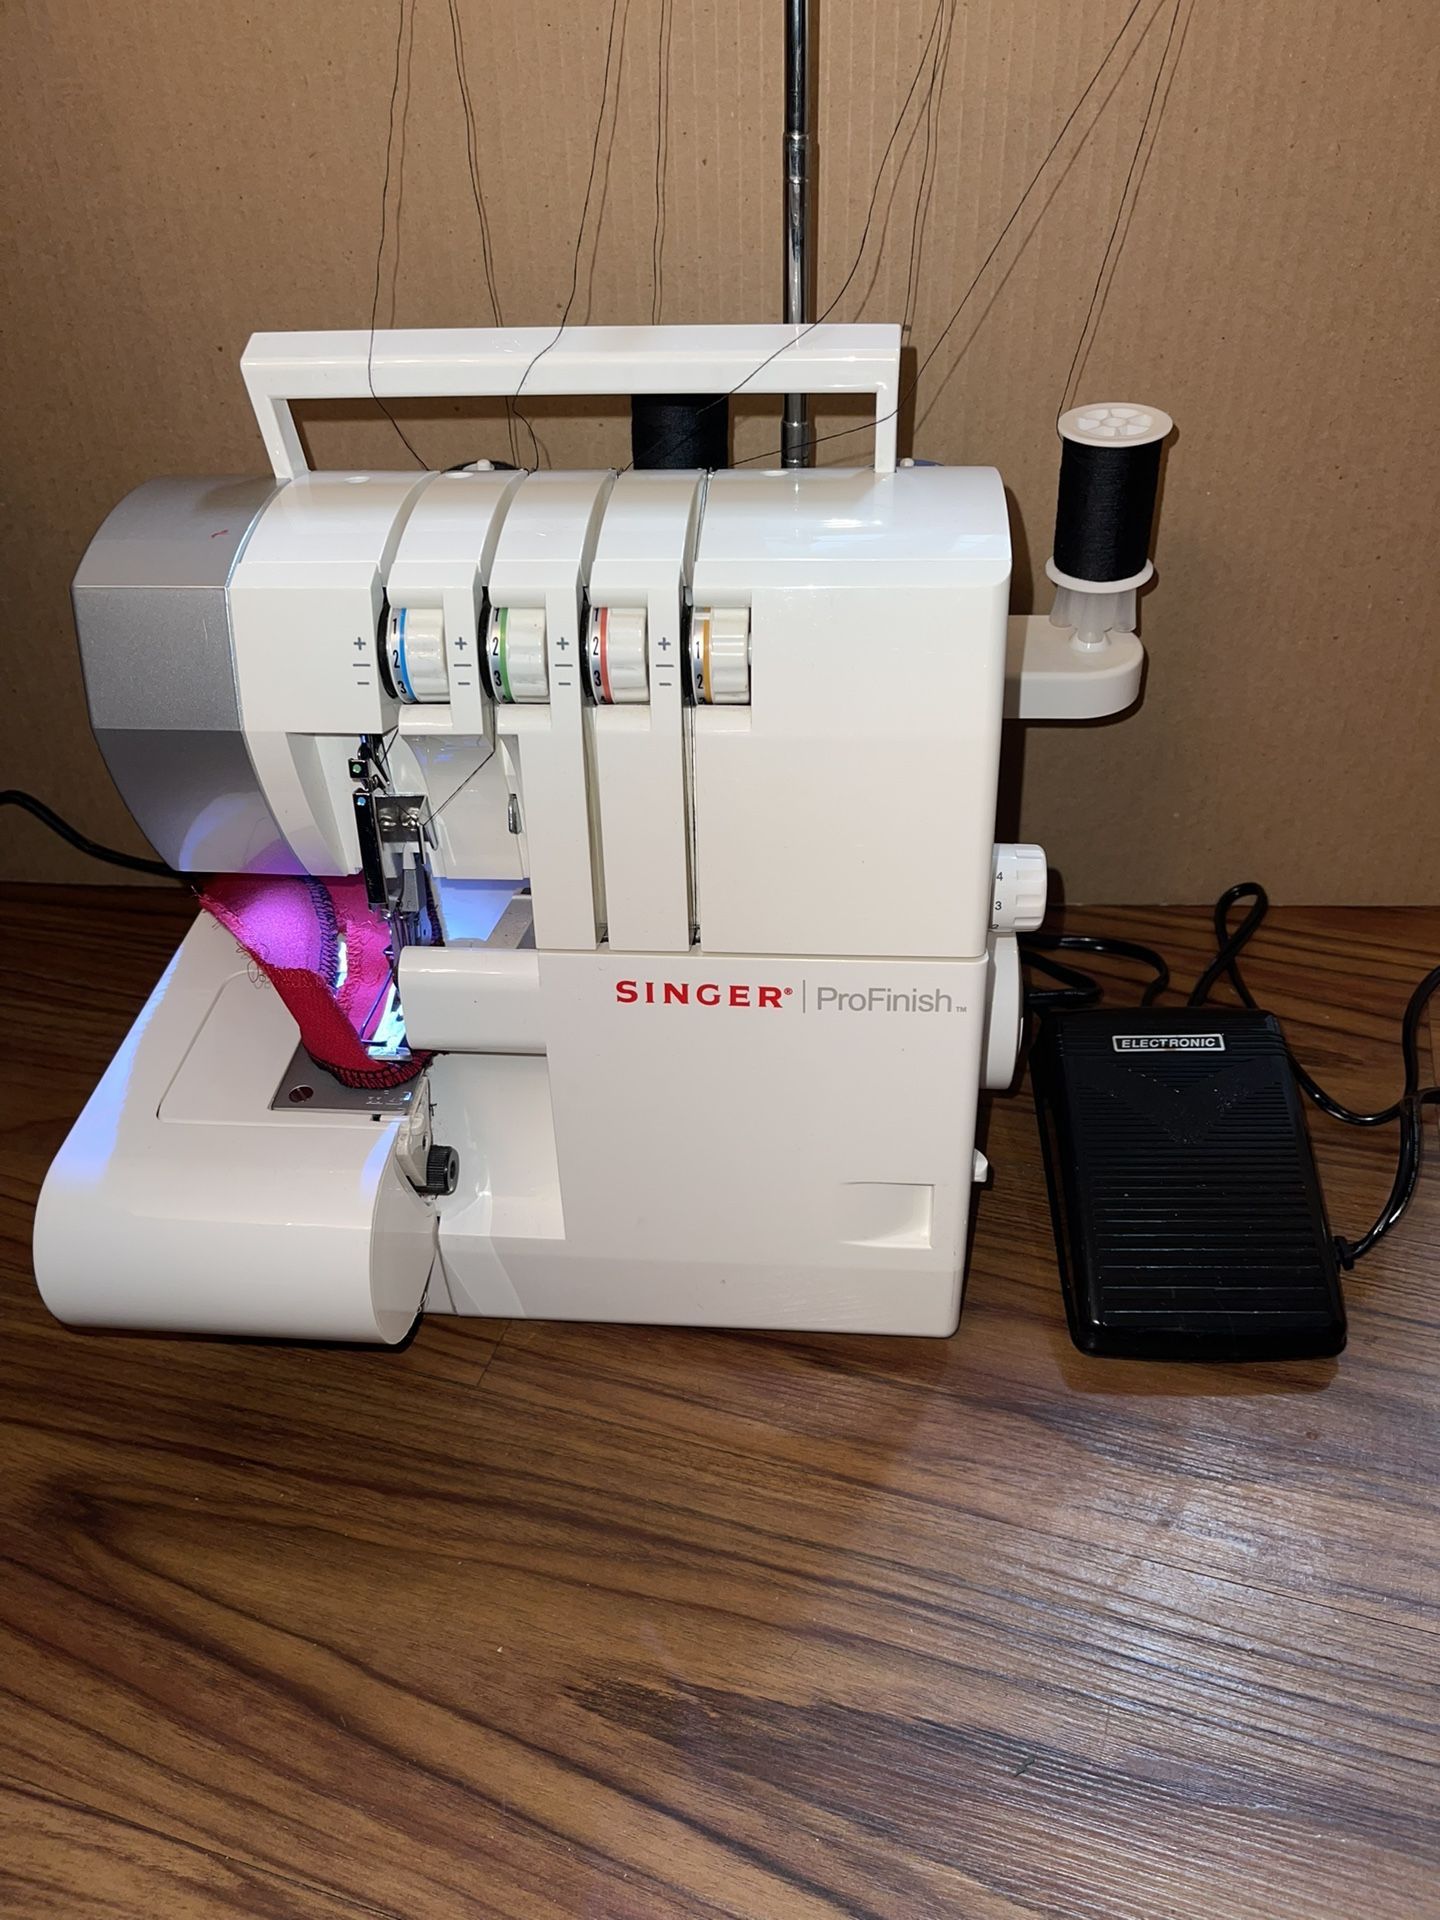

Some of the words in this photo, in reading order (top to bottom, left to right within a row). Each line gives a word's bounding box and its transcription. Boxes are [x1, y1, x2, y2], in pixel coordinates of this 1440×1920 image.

[392, 618, 397, 634] 1
[491, 637, 499, 656] 2
[592, 636, 599, 656] 2
[696, 641, 700, 659] 1
[393, 650, 400, 668] 2
[493, 670, 502, 687] 3
[593, 670, 602, 687] 3
[696, 674, 703, 689] 2
[397, 681, 407, 694] 3
[996, 872, 1004, 881] 4
[994, 901, 1002, 911] 3
[1121, 1038, 1216, 1048] ELECTRONIC
